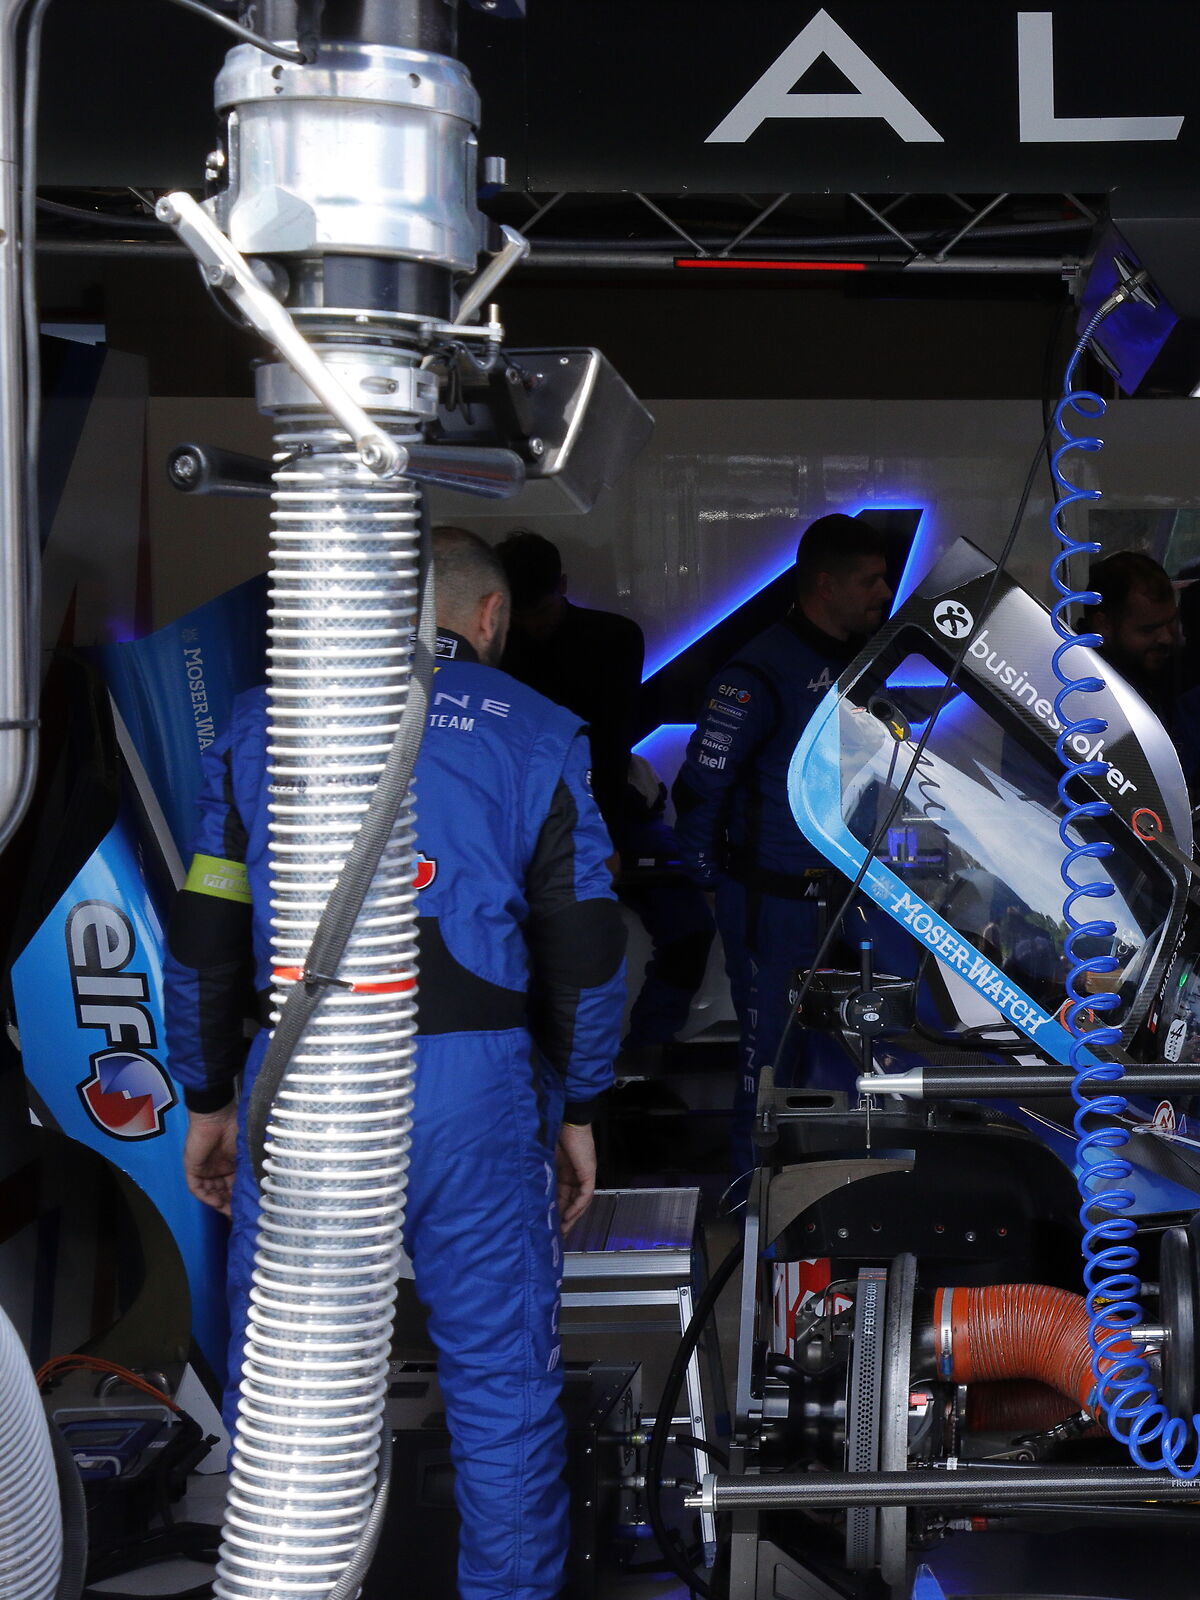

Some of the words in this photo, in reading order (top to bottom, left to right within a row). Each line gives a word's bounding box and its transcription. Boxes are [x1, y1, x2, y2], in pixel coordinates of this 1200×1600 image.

[719, 684, 738, 697] elf
[968, 630, 1138, 796] businesoler
[429, 715, 475, 731] TEAM
[702, 739, 730, 752] BAHCO
[698, 750, 727, 769] ixell
[890, 892, 1047, 1035] MOSER.WATCH
[68, 902, 156, 1046] elf
[1171, 1479, 1196, 1488] FRONT
